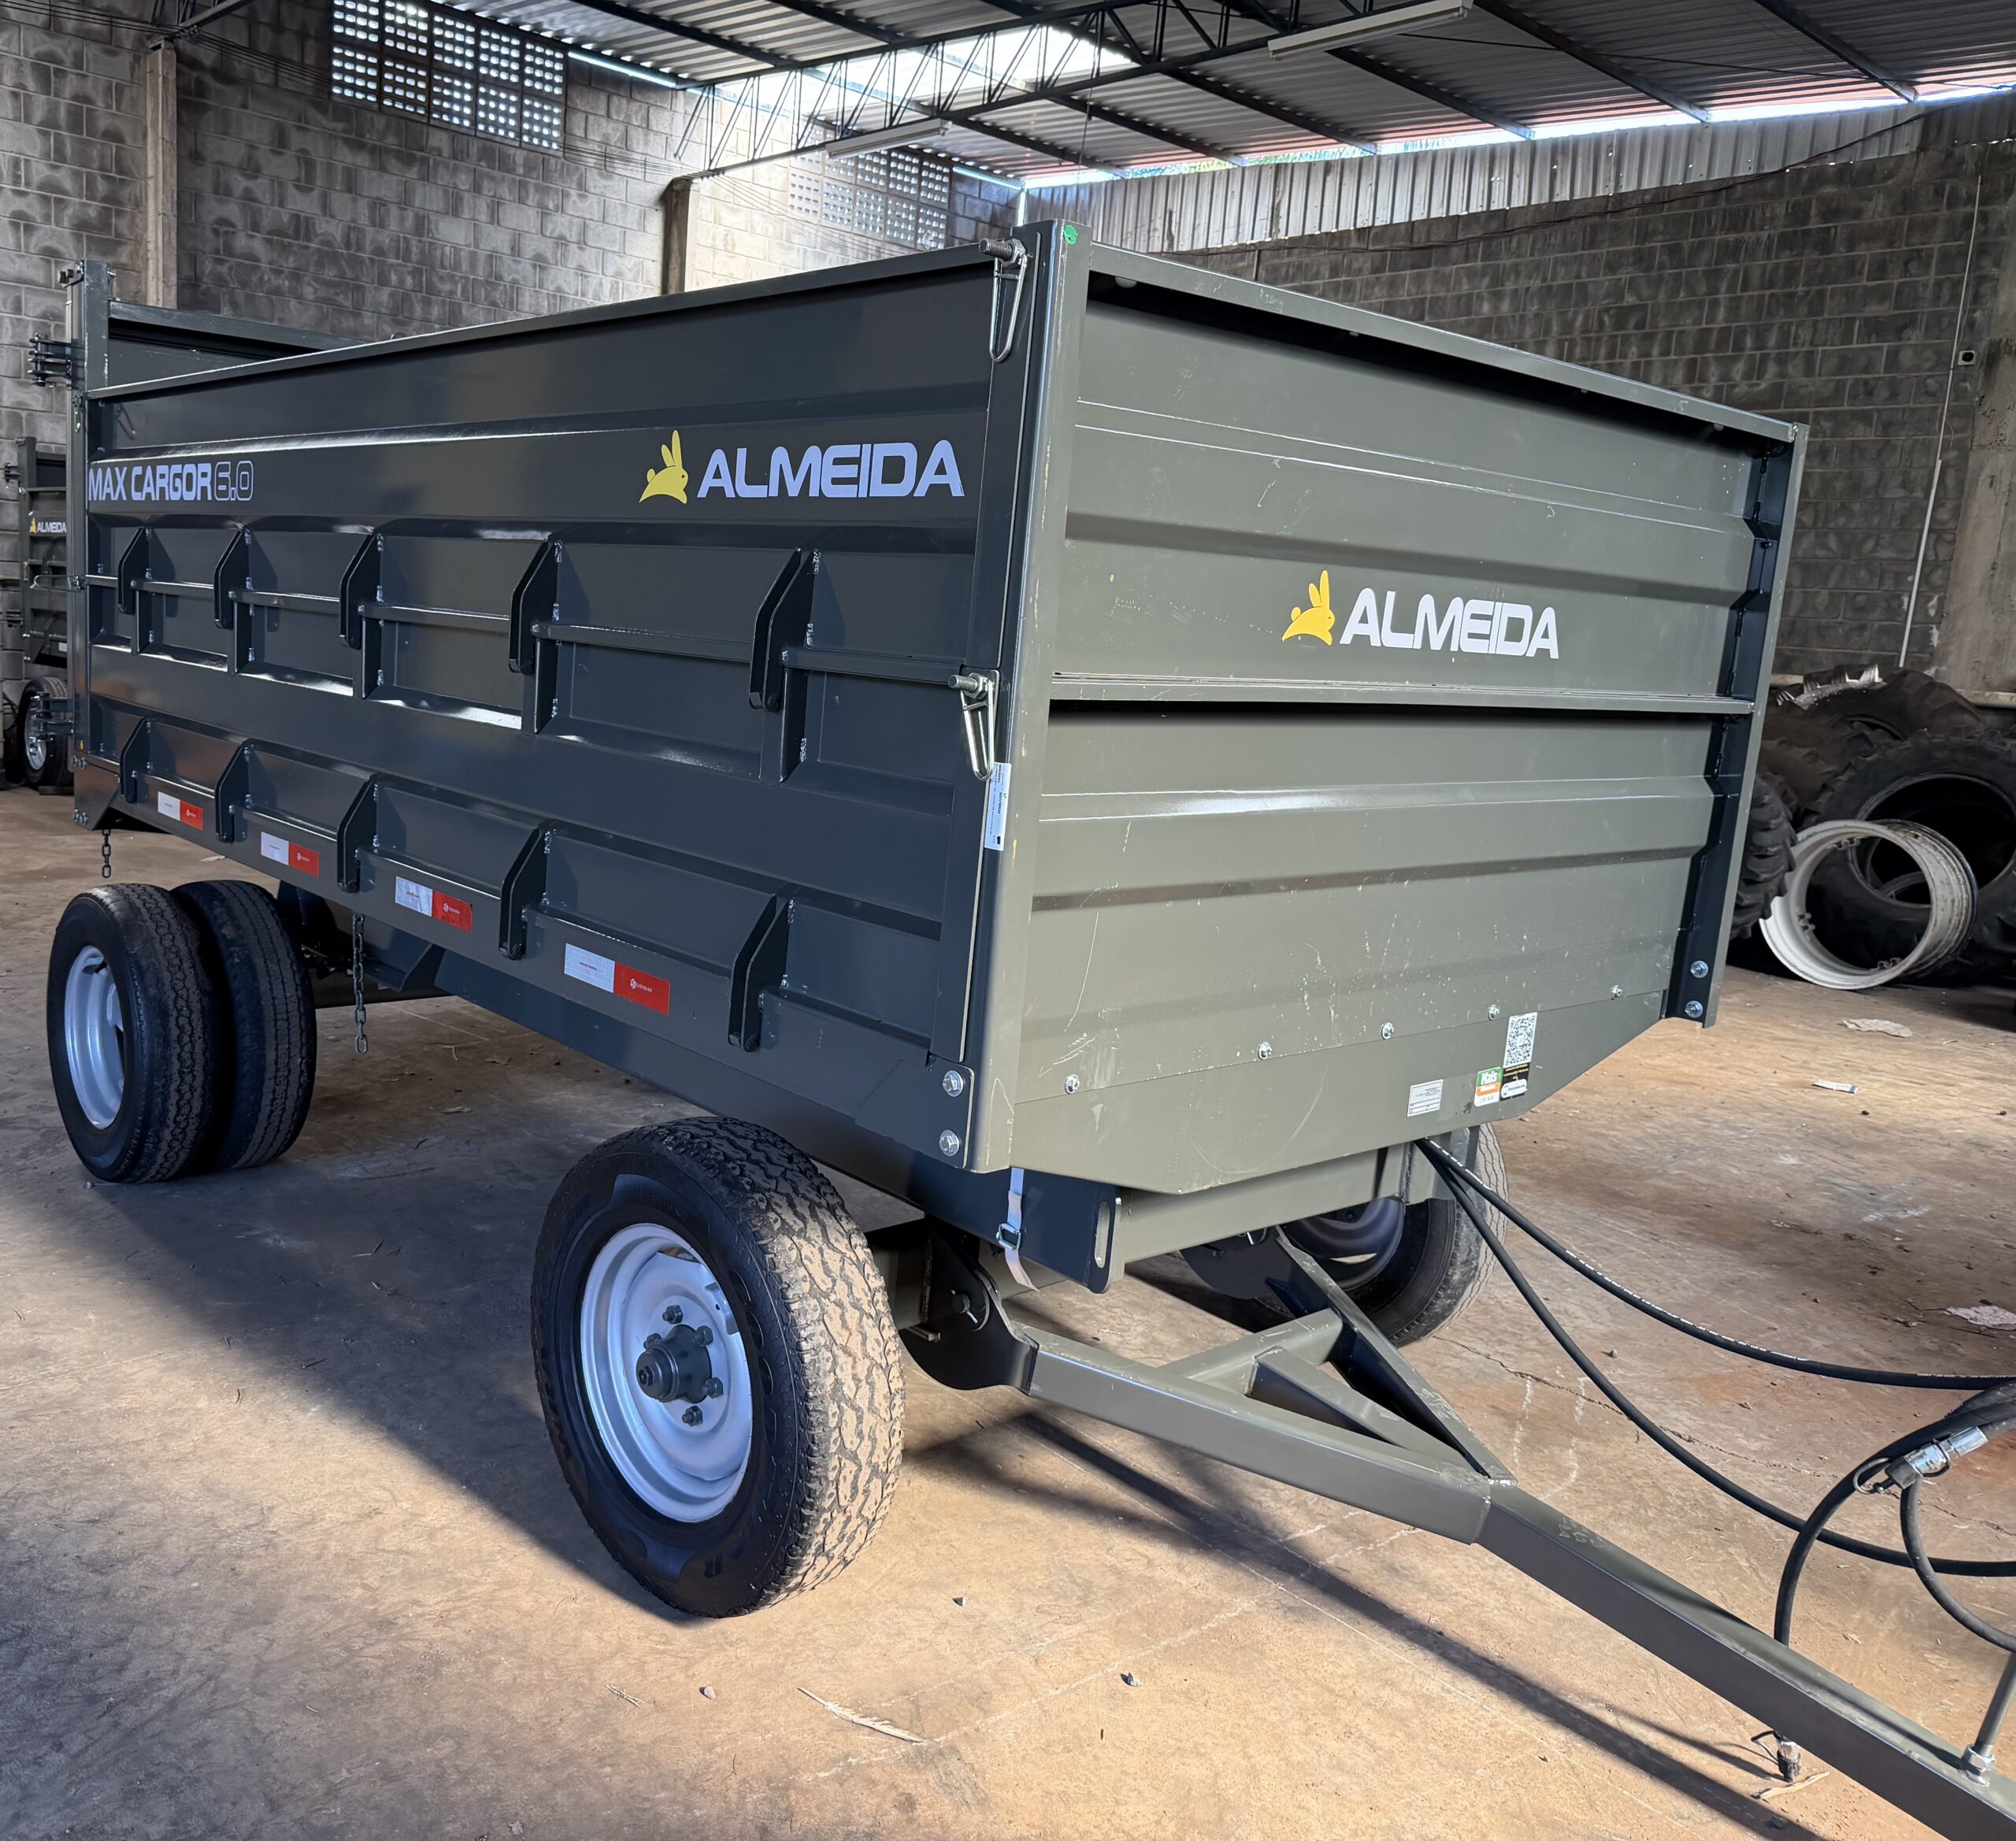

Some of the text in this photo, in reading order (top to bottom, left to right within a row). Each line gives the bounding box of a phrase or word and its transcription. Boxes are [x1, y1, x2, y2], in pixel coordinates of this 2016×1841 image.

[88, 460, 254, 502] MAX CARGOR 6.0
[697, 439, 965, 498] ALMEIDA
[37, 521, 68, 533] ALMEIDA
[1339, 587, 1559, 659] ALMEIDA
